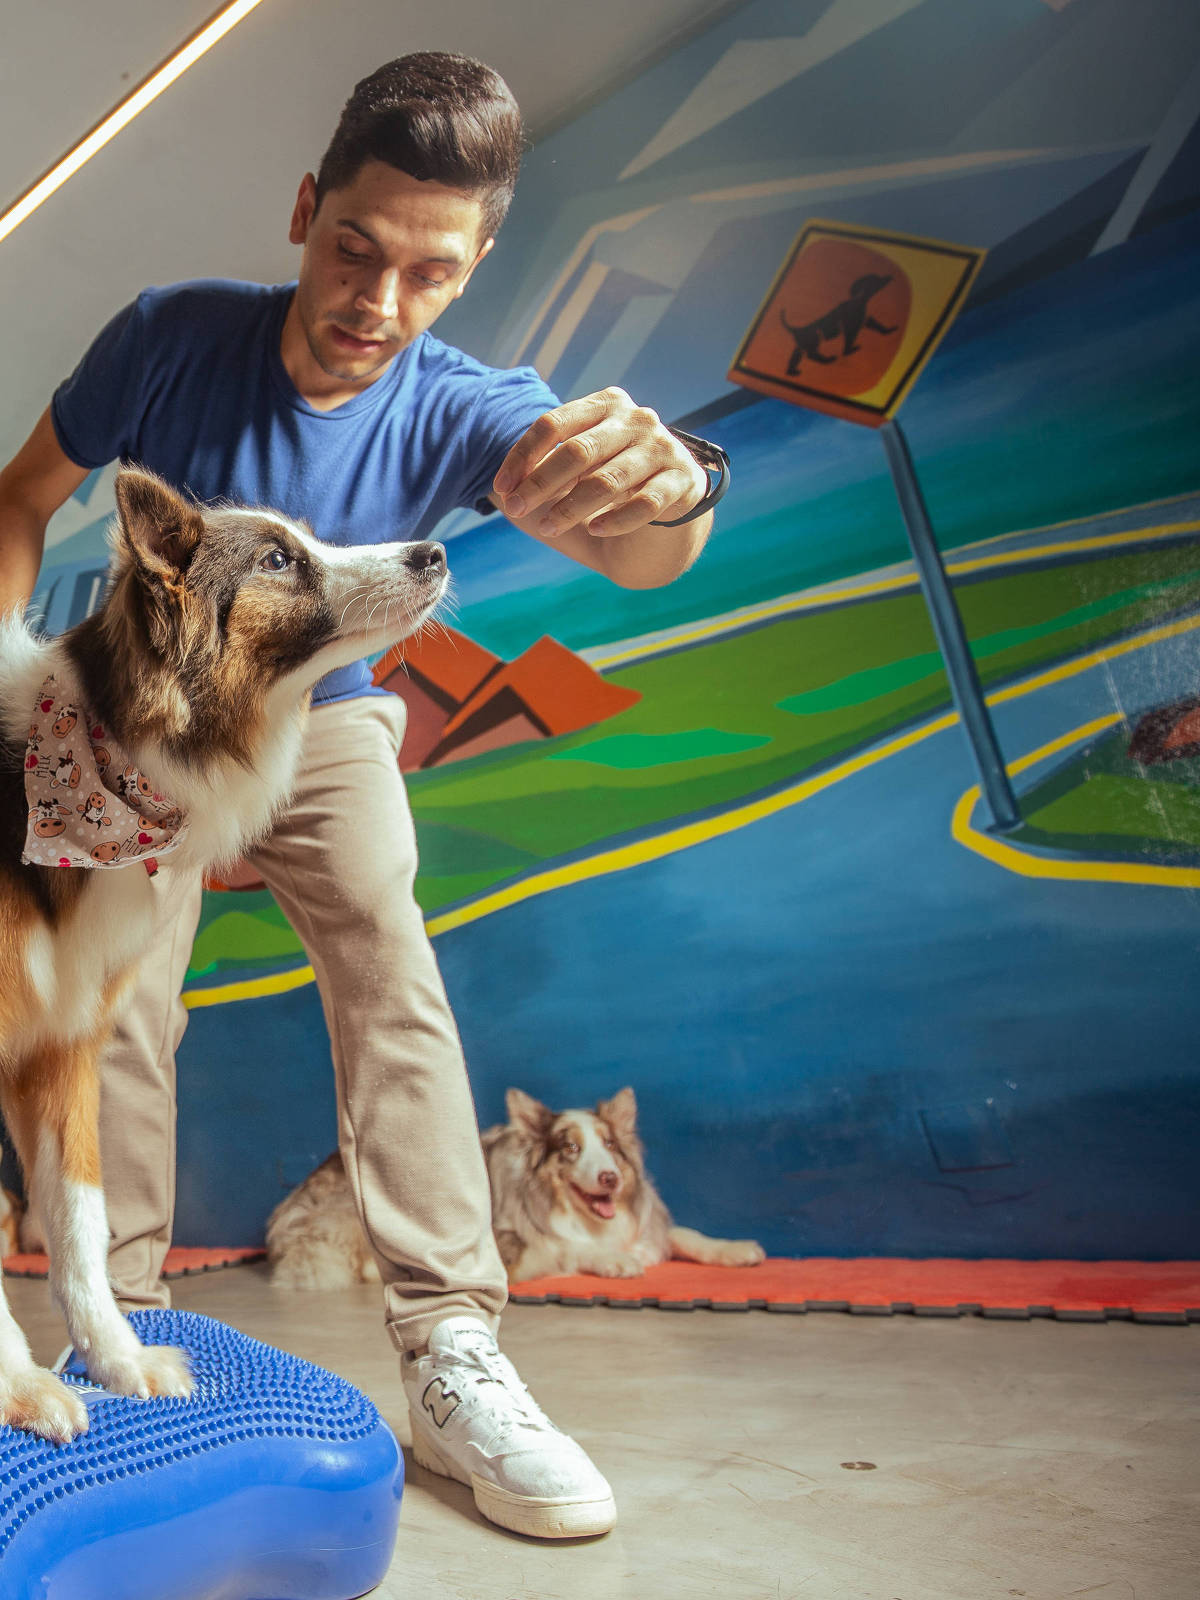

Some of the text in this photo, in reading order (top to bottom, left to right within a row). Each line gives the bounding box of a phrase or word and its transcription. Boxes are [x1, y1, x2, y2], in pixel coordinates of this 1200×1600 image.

[36, 754, 52, 778] MILK
[130, 829, 140, 839] I
[121, 838, 146, 856] MILK
